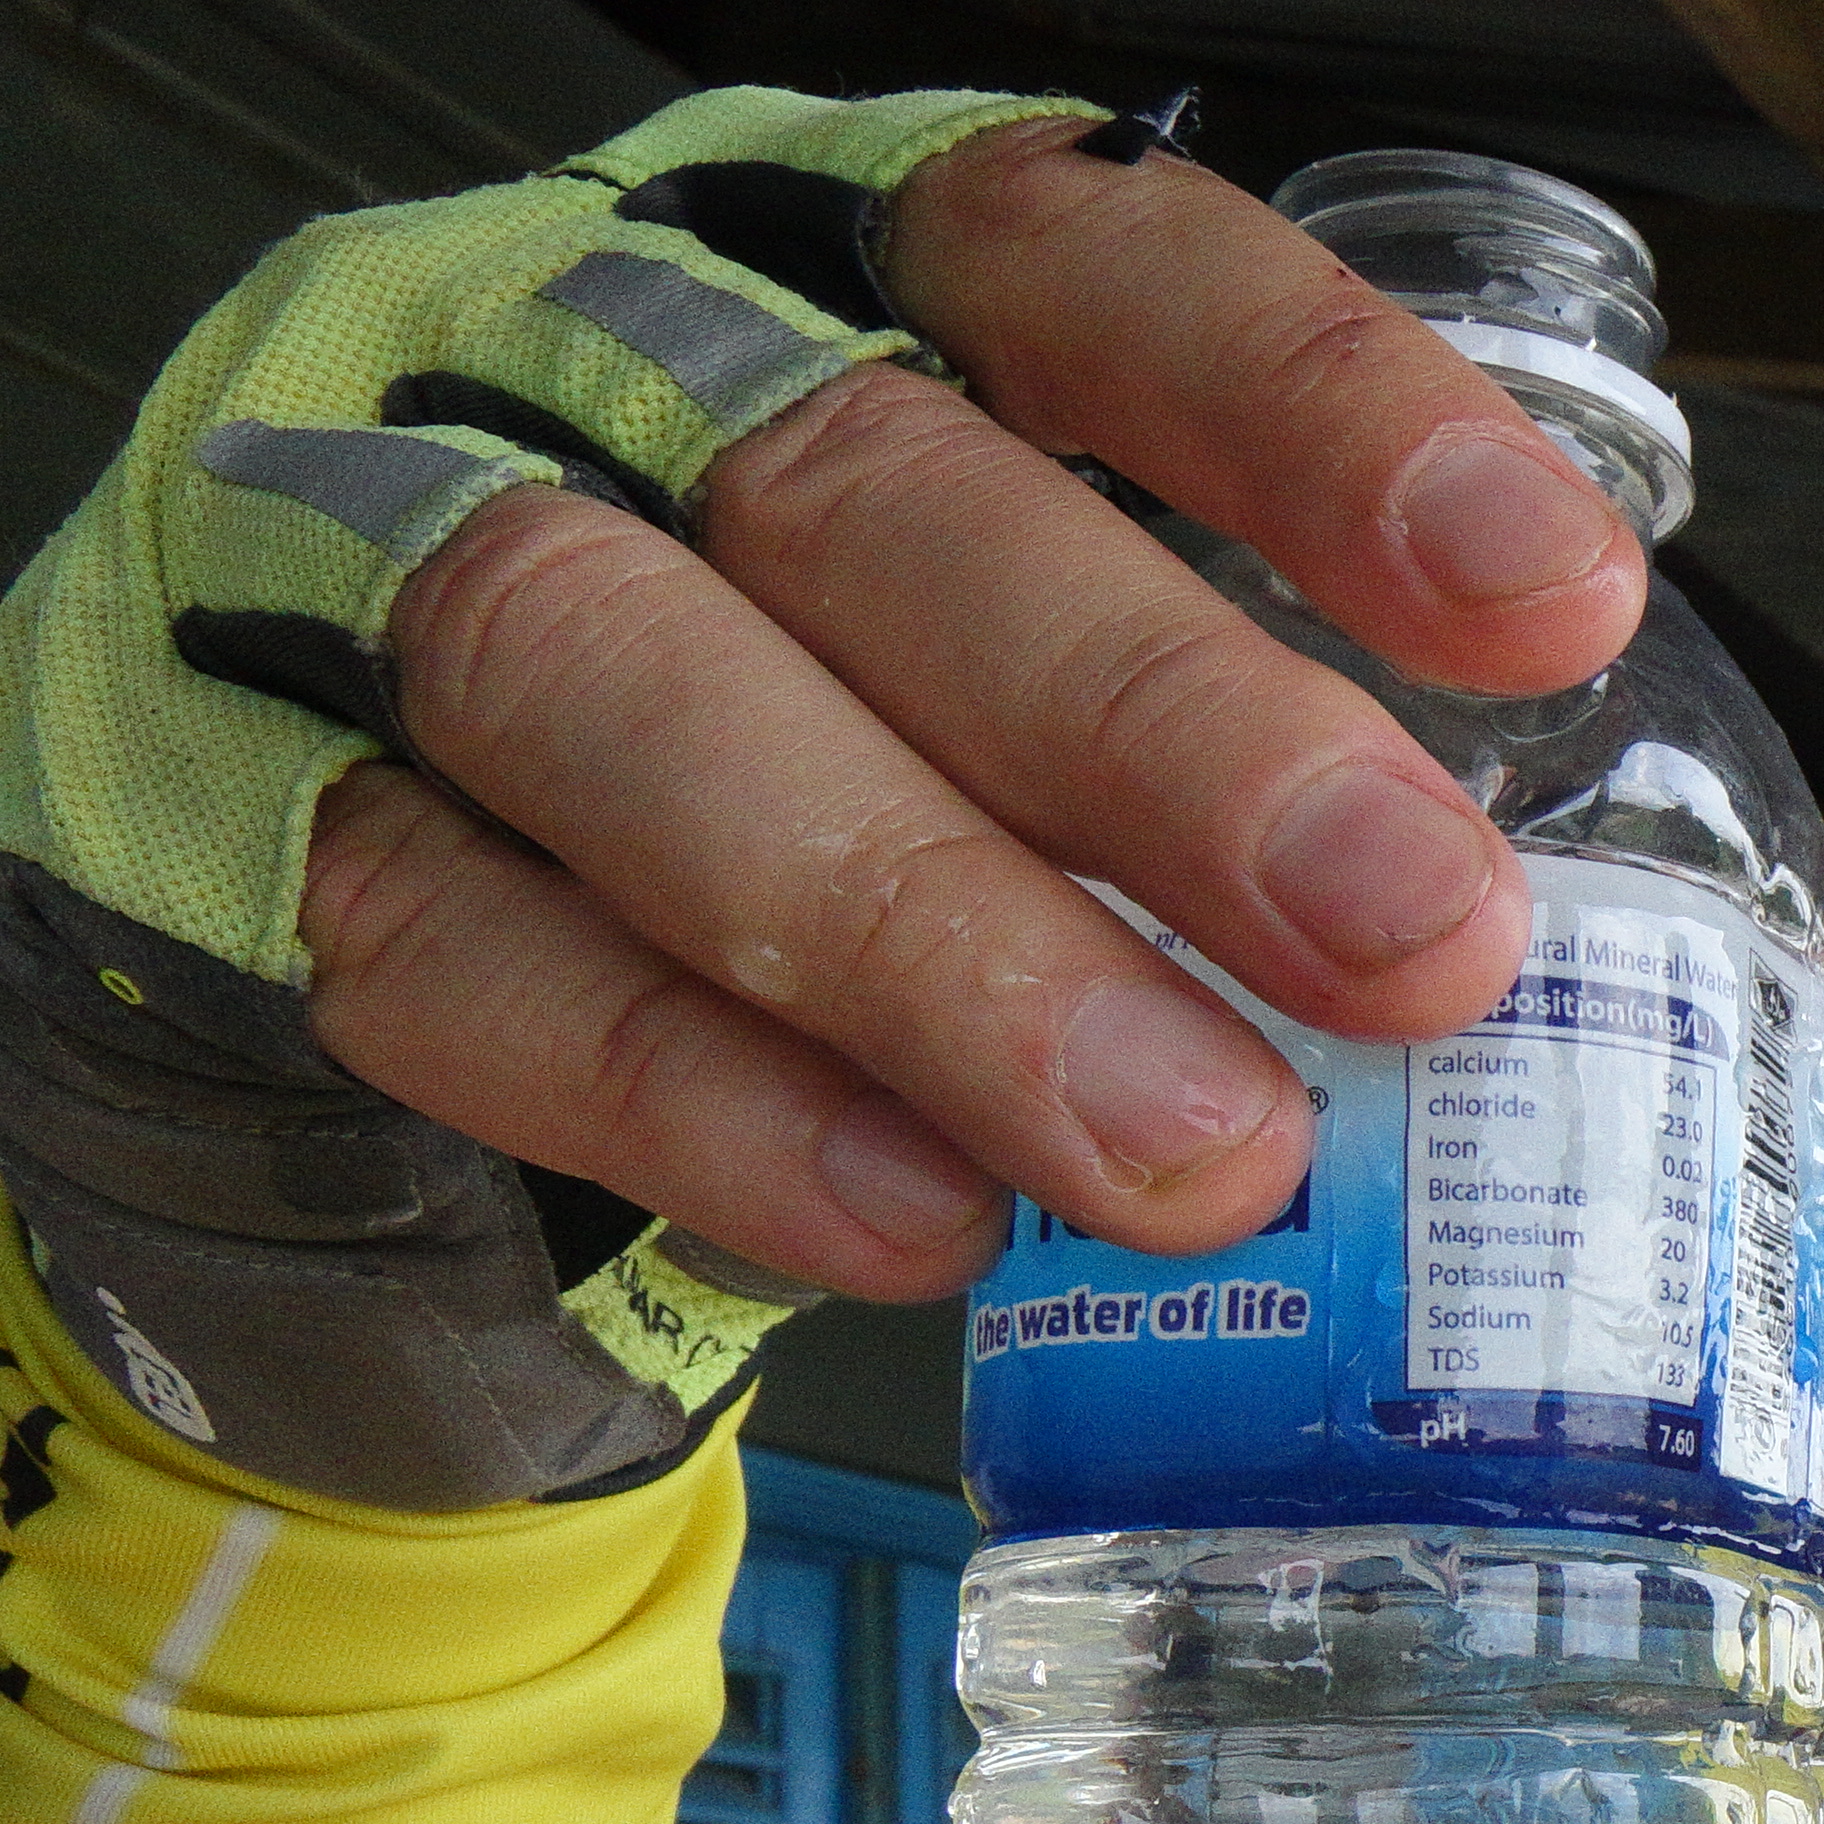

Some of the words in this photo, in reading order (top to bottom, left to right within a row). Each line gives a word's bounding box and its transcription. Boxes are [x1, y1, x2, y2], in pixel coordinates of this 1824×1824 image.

[1526, 933, 1577, 962] ural
[1585, 938, 1681, 981] Mineral
[1684, 956, 1738, 1000] Water
[1491, 986, 1713, 1049] position(mg/L)
[1427, 1049, 1530, 1077] calcium
[1662, 1073, 1703, 1101] 54.1
[1427, 1091, 1536, 1119] chloride
[1660, 1114, 1703, 1142] 23.0
[1428, 1135, 1478, 1159] Iron
[1427, 1178, 1589, 1207] Bicarbonate
[1660, 1196, 1698, 1225] 380
[1427, 1220, 1585, 1250] Magnesium
[1660, 1237, 1687, 1262] 20
[1427, 1262, 1566, 1290] Potassium
[1659, 1279, 1690, 1305] 3.2
[976, 1307, 1010, 1357] the
[1016, 1291, 1143, 1342] water
[1157, 1288, 1211, 1333] of
[1225, 1285, 1308, 1333] life
[1427, 1305, 1532, 1331] Sodium
[1427, 1348, 1480, 1373] TDS
[1657, 1362, 1686, 1388] 133
[1419, 1410, 1468, 1449] pH
[1658, 1424, 1696, 1457] 7.60
